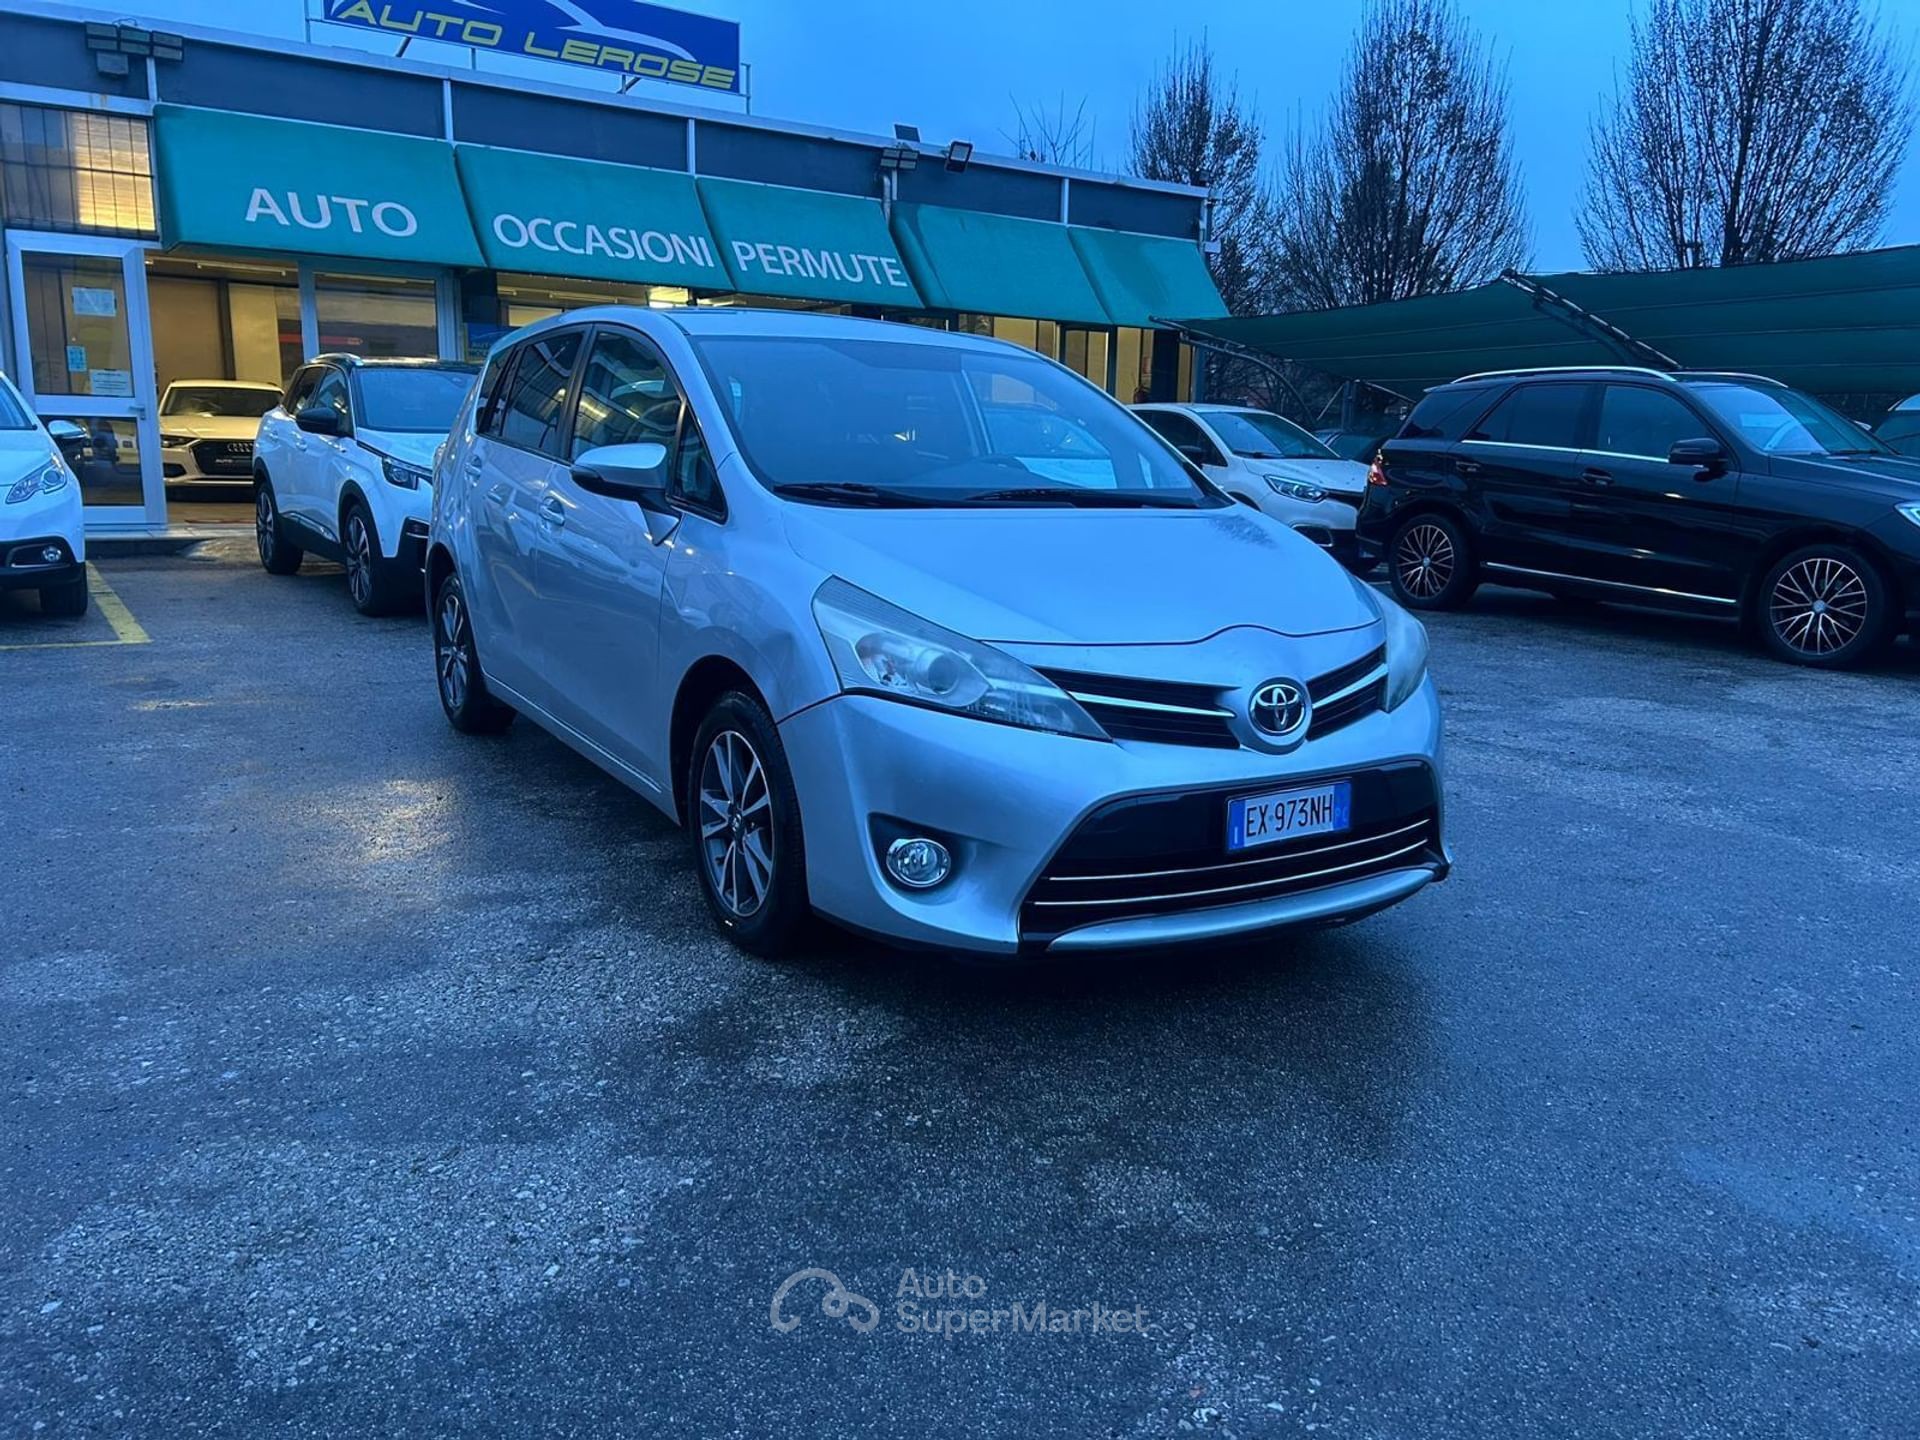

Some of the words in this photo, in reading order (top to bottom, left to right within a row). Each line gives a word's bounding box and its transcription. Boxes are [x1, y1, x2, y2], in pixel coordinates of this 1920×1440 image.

[336, 0, 503, 47] AUTO
[523, 30, 737, 90] LEROSE
[245, 187, 418, 237] AUTO
[492, 213, 715, 268] OCCASIONI
[731, 240, 909, 288] PERMUTE
[1245, 803, 1269, 838] EX
[1273, 793, 1334, 832] 973NH
